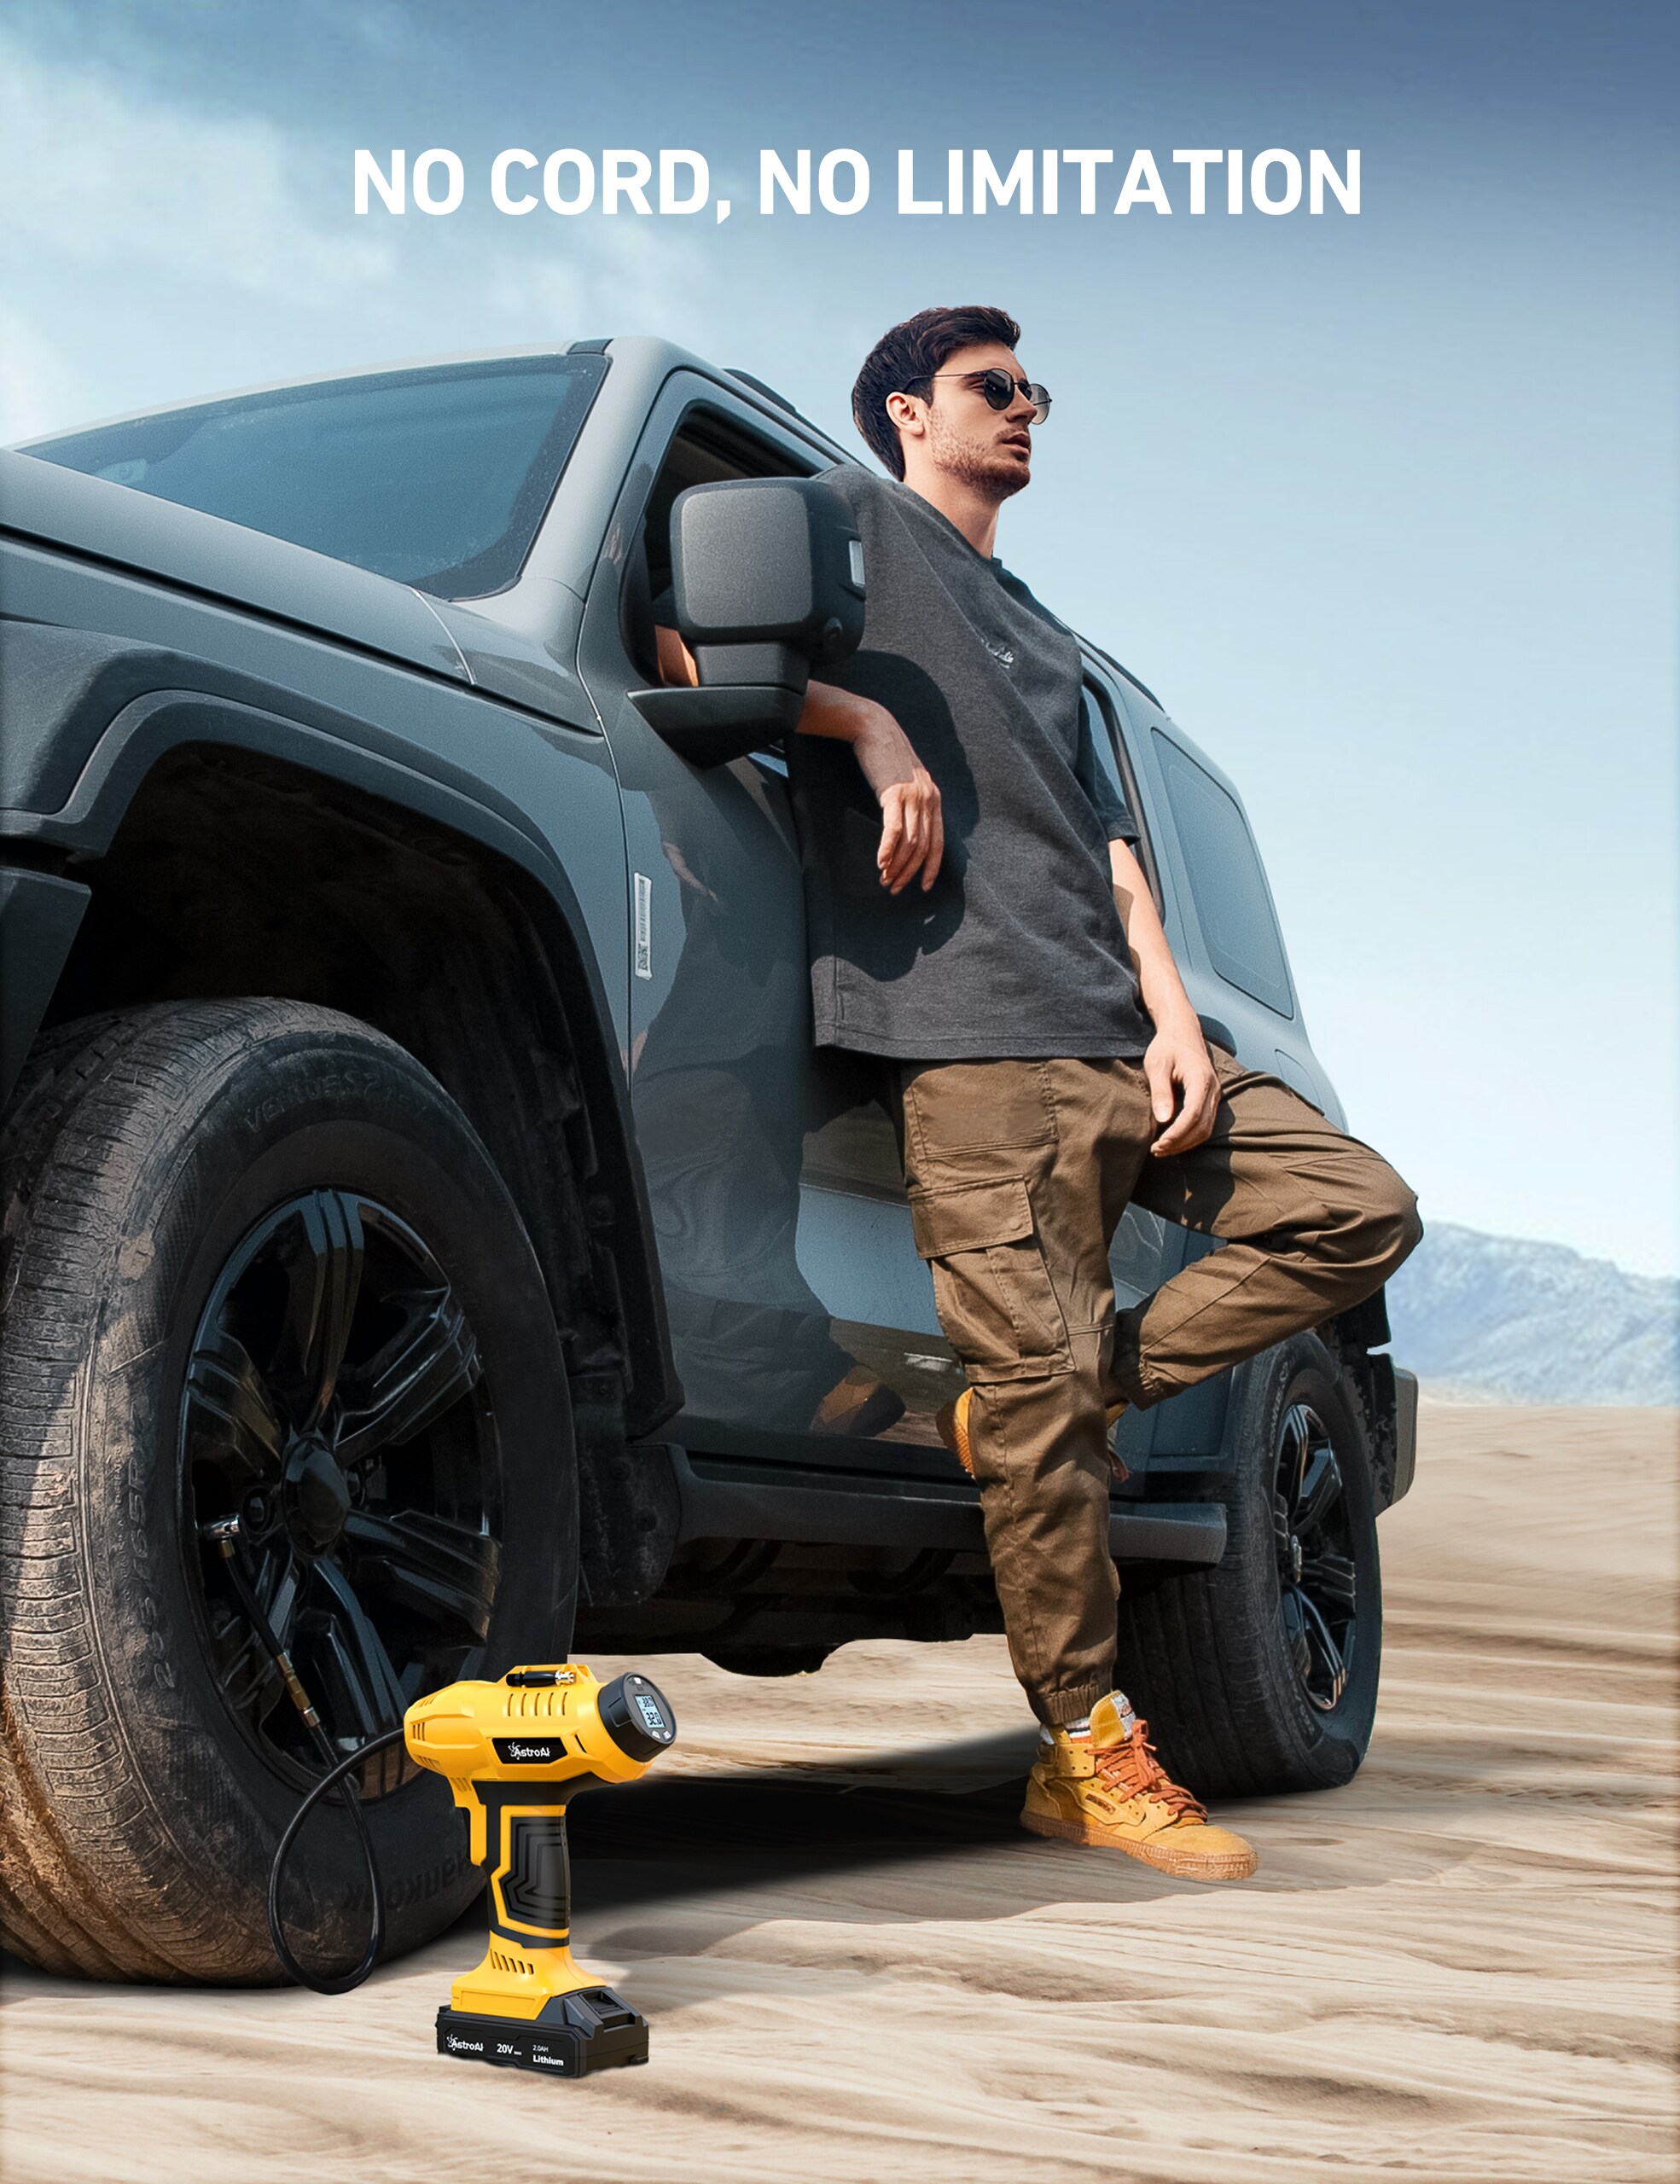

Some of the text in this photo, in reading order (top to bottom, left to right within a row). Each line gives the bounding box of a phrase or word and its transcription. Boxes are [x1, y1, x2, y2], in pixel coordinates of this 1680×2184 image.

[509, 1745, 550, 1759] AstroAI
[449, 2037, 484, 2052] AstroAI
[497, 2043, 514, 2054] 20V
[532, 2054, 564, 2066] Lithium
